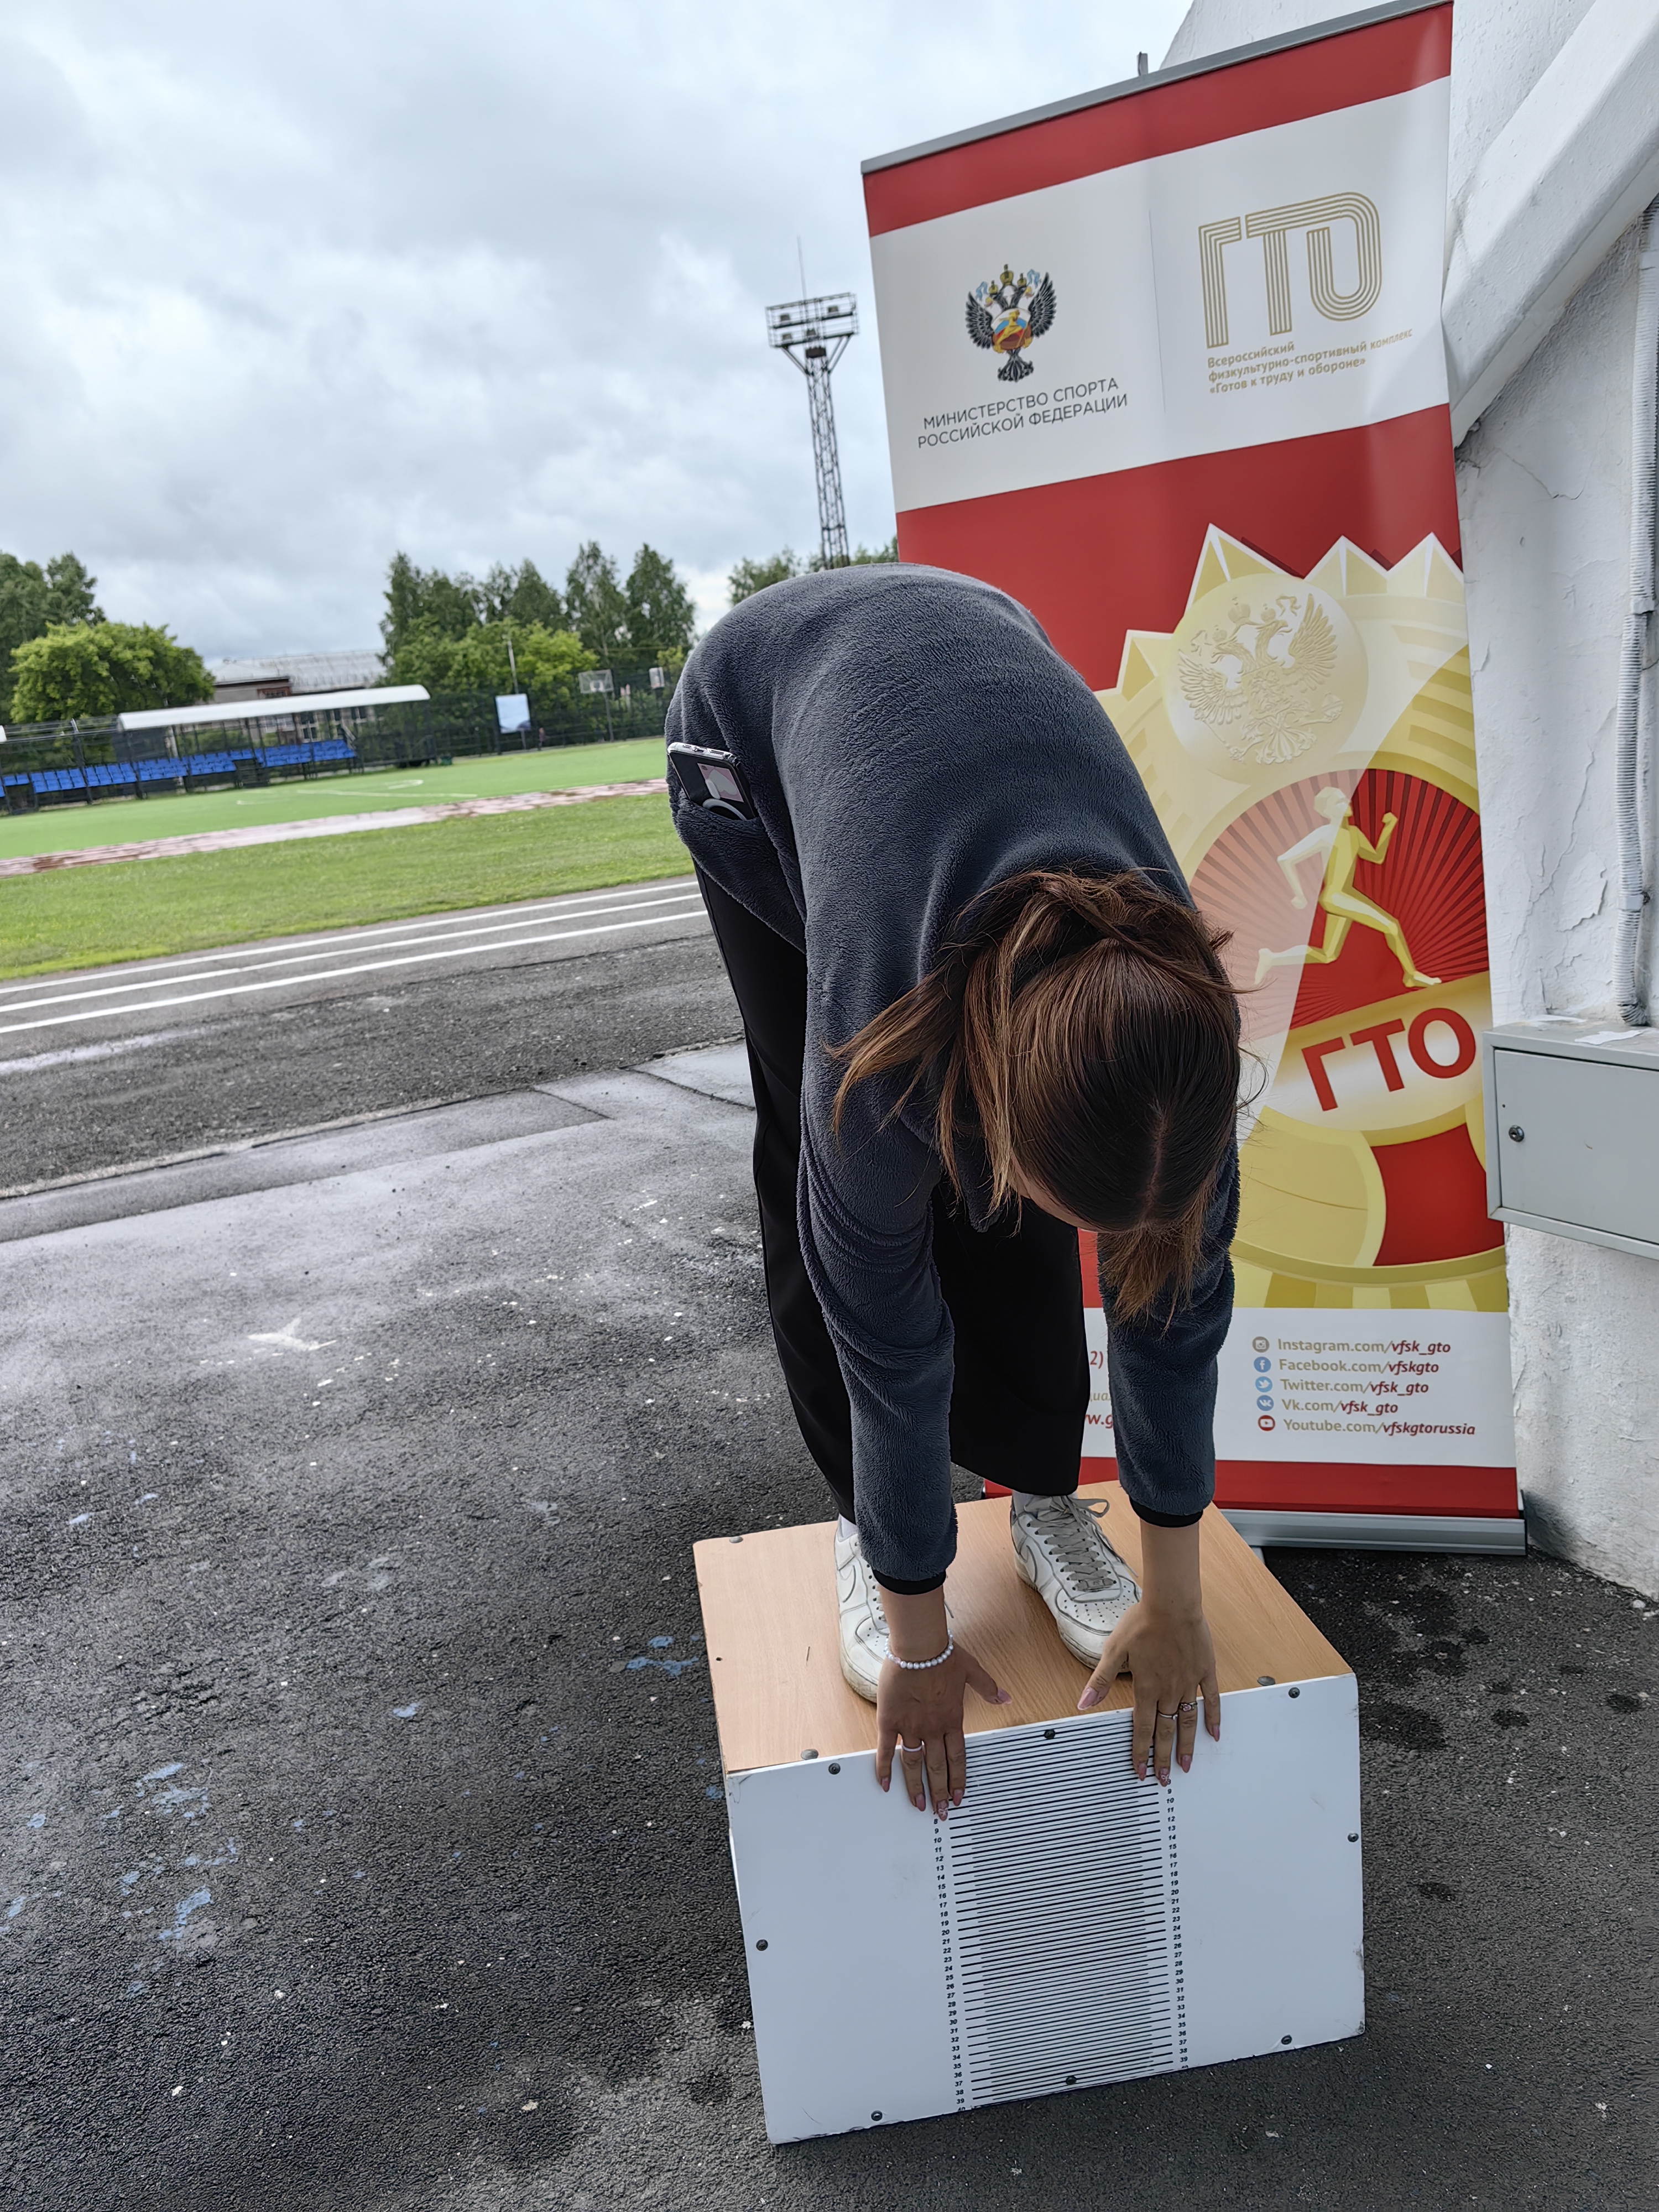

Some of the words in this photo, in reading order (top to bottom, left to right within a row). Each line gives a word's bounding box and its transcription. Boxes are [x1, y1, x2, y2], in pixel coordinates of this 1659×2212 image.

[1198, 191, 1383, 349] ГТО
[1207, 341, 1295, 369] Всероссийский
[1208, 342, 1367, 383] физкультурно-спортивный
[1370, 328, 1413, 351] комплекс
[1209, 379, 1248, 394] «Готов
[1260, 370, 1294, 387] труду
[1297, 369, 1305, 378] и
[1308, 357, 1366, 378] обороне»
[923, 392, 1048, 431] МИНИСТЕРСТВО
[1052, 377, 1119, 403] СПОРТА
[917, 413, 1024, 449] РОССИЙСКОЙ
[1028, 393, 1128, 425] ФЕДЕРАЦИИ
[1301, 1007, 1477, 1112] ГТО
[1277, 1338, 1451, 1355] Instagram.com/vfsk_gto
[1279, 1358, 1439, 1376] Facebook.com/vfskgto
[1280, 1378, 1430, 1396] Twitter.com/vfsk_gto
[1281, 1398, 1399, 1416] Vk.com/vfsk_gto
[1283, 1418, 1476, 1436] Youtube.com/vfskgtorussia
